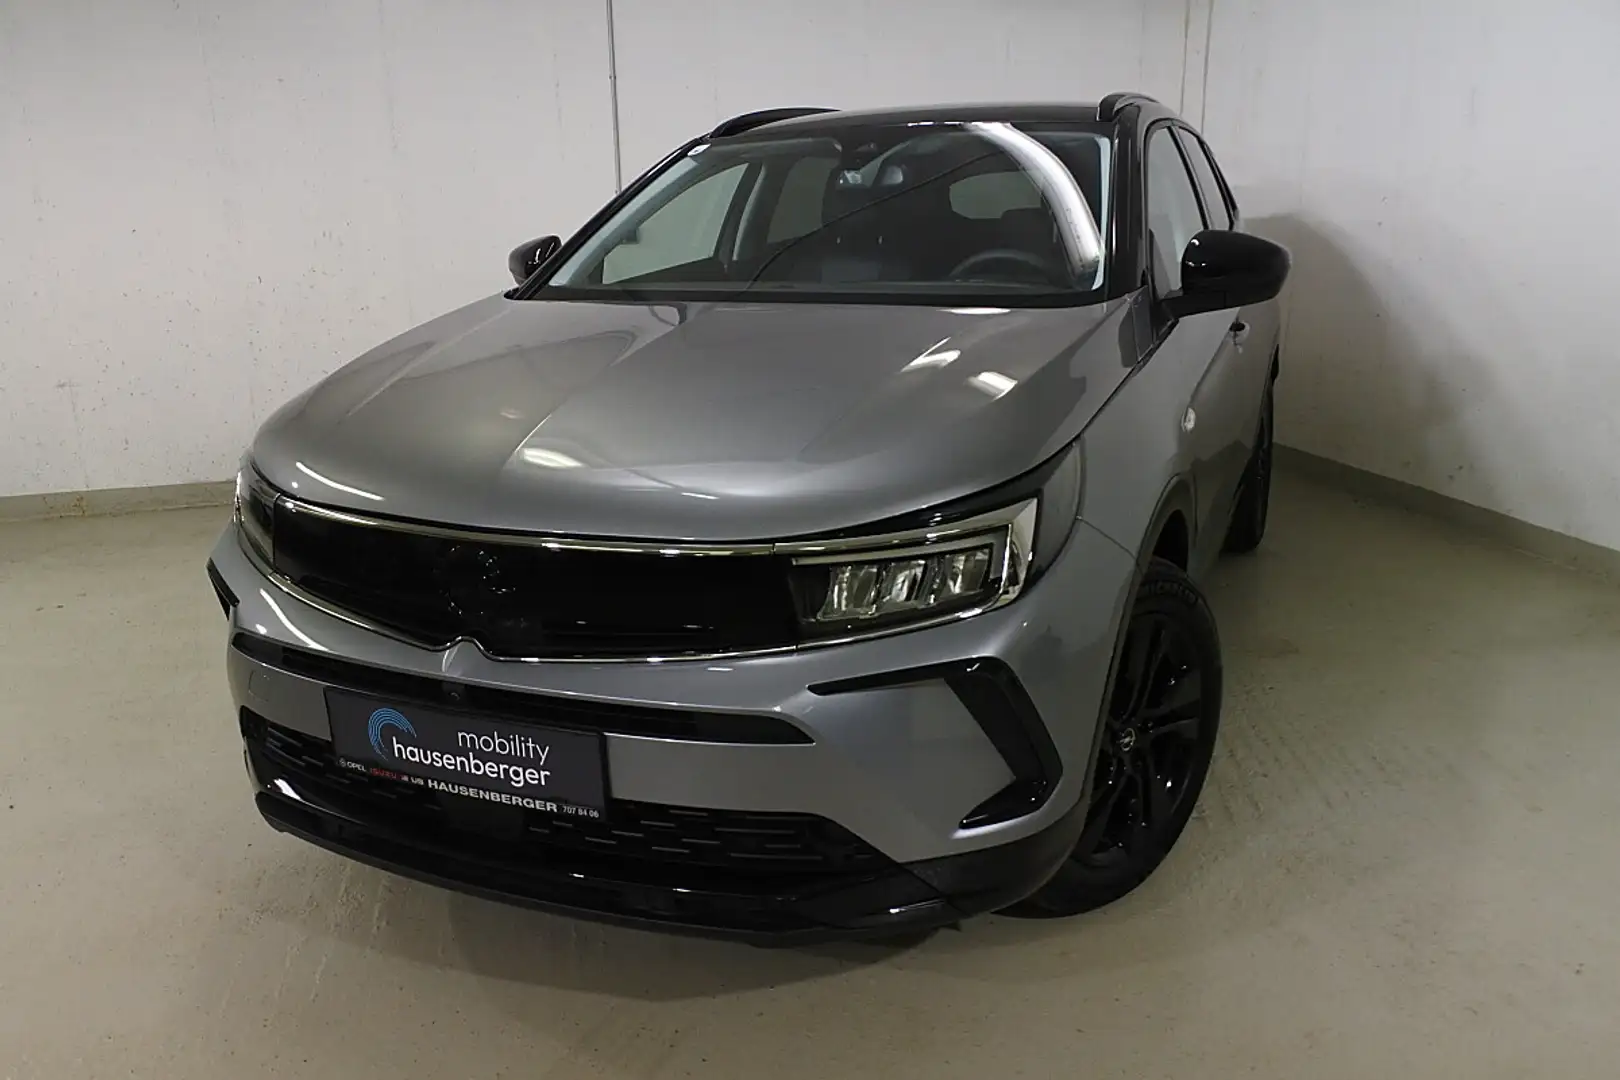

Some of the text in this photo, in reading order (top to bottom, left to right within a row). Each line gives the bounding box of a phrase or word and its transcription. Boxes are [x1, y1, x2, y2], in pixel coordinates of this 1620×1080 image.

[392, 736, 551, 788] hausenberger
[457, 730, 550, 766] mobility
[347, 761, 367, 772] OPEL
[427, 779, 558, 813] HAUSENBERGER
[563, 805, 576, 815] 707
